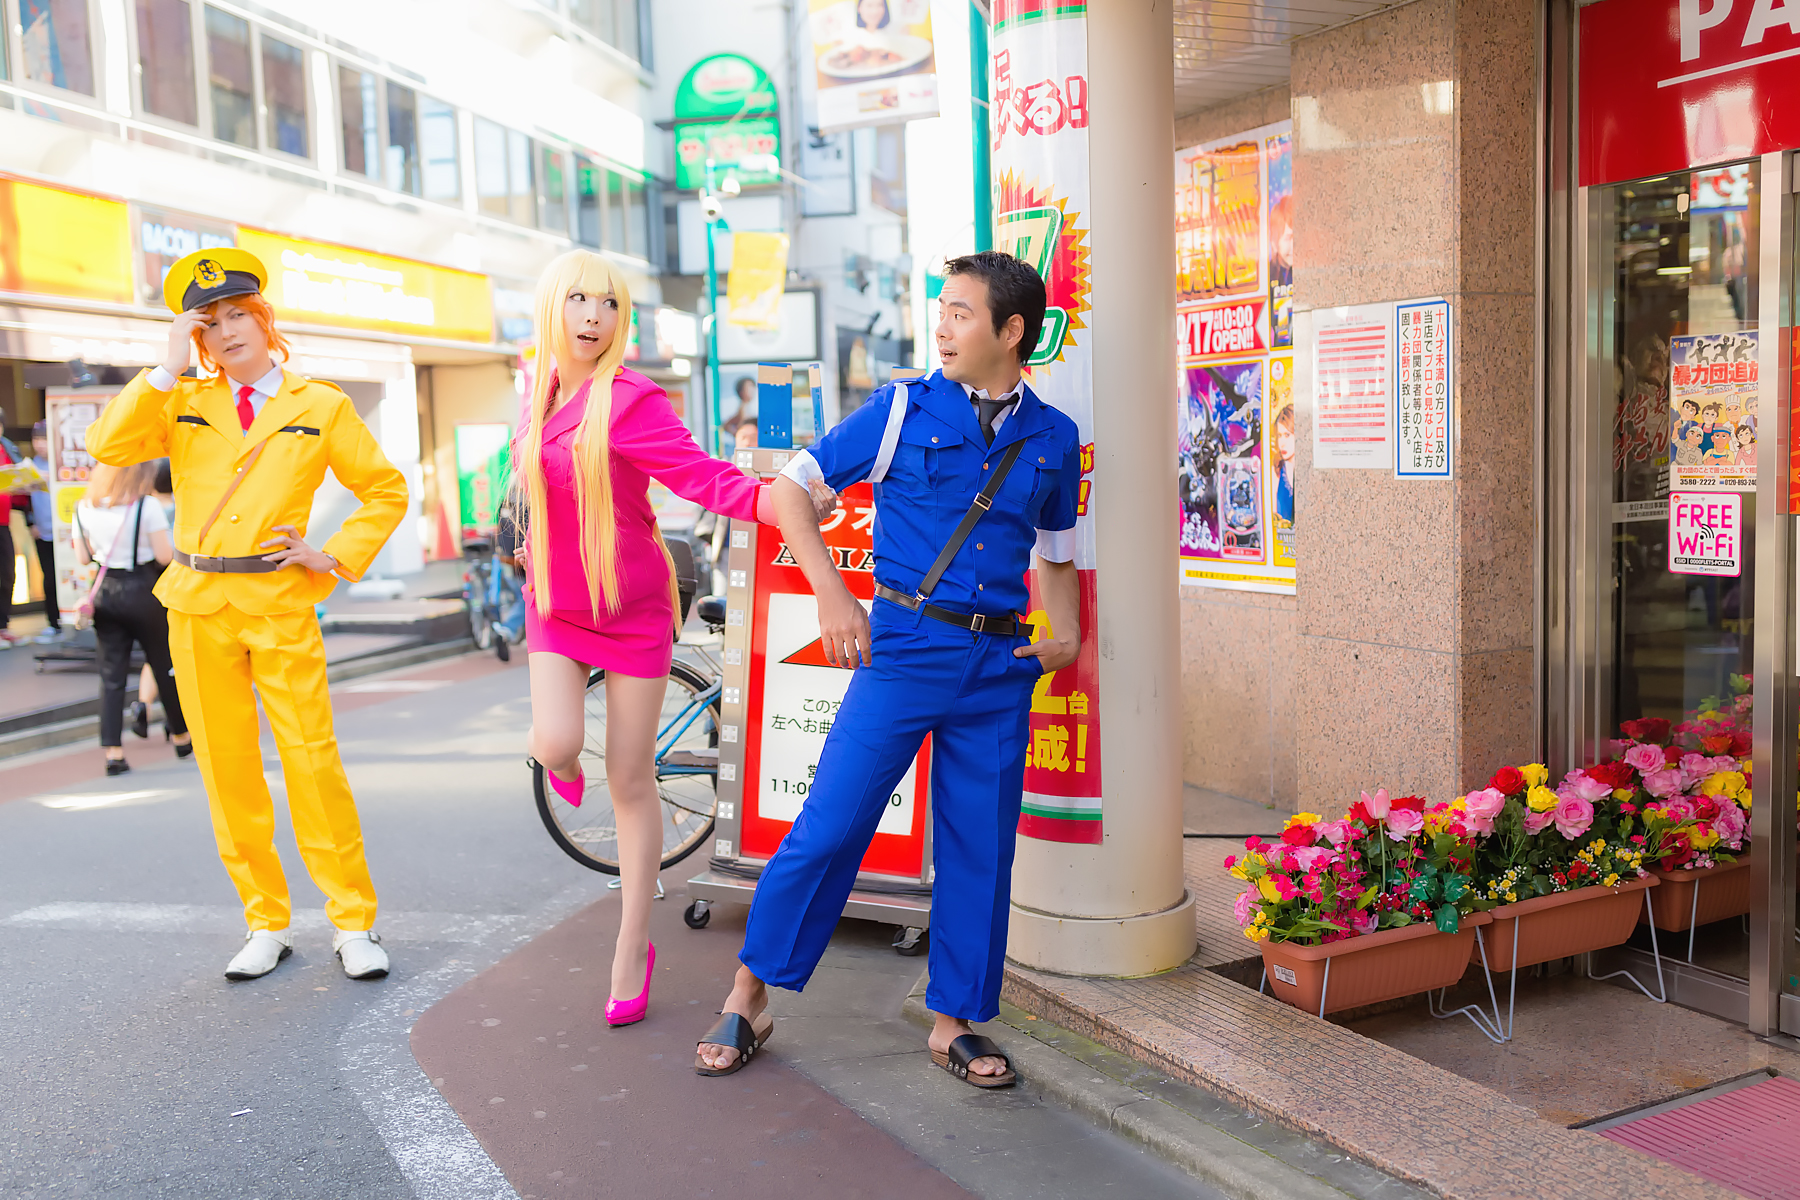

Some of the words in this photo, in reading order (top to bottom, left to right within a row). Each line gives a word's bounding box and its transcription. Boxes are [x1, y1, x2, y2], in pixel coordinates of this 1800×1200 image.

[995, 75, 1089, 150] べる!
[1218, 305, 1253, 330] 10:00
[1212, 326, 1254, 352] OPEN!!
[1401, 313, 1411, 445] 固くお断り致します。
[1412, 311, 1422, 468] 暴力団関係者等の入店は
[1424, 310, 1434, 468] 当店でプロと見なした方
[1435, 309, 1445, 467] 十八才未満の方プロ及び
[1676, 504, 1733, 528] FREE
[771, 543, 876, 573] AIA
[1676, 531, 1733, 558] Wi-Fi
[771, 714, 834, 735] 左へお曲
[771, 778, 814, 796] 11:0
